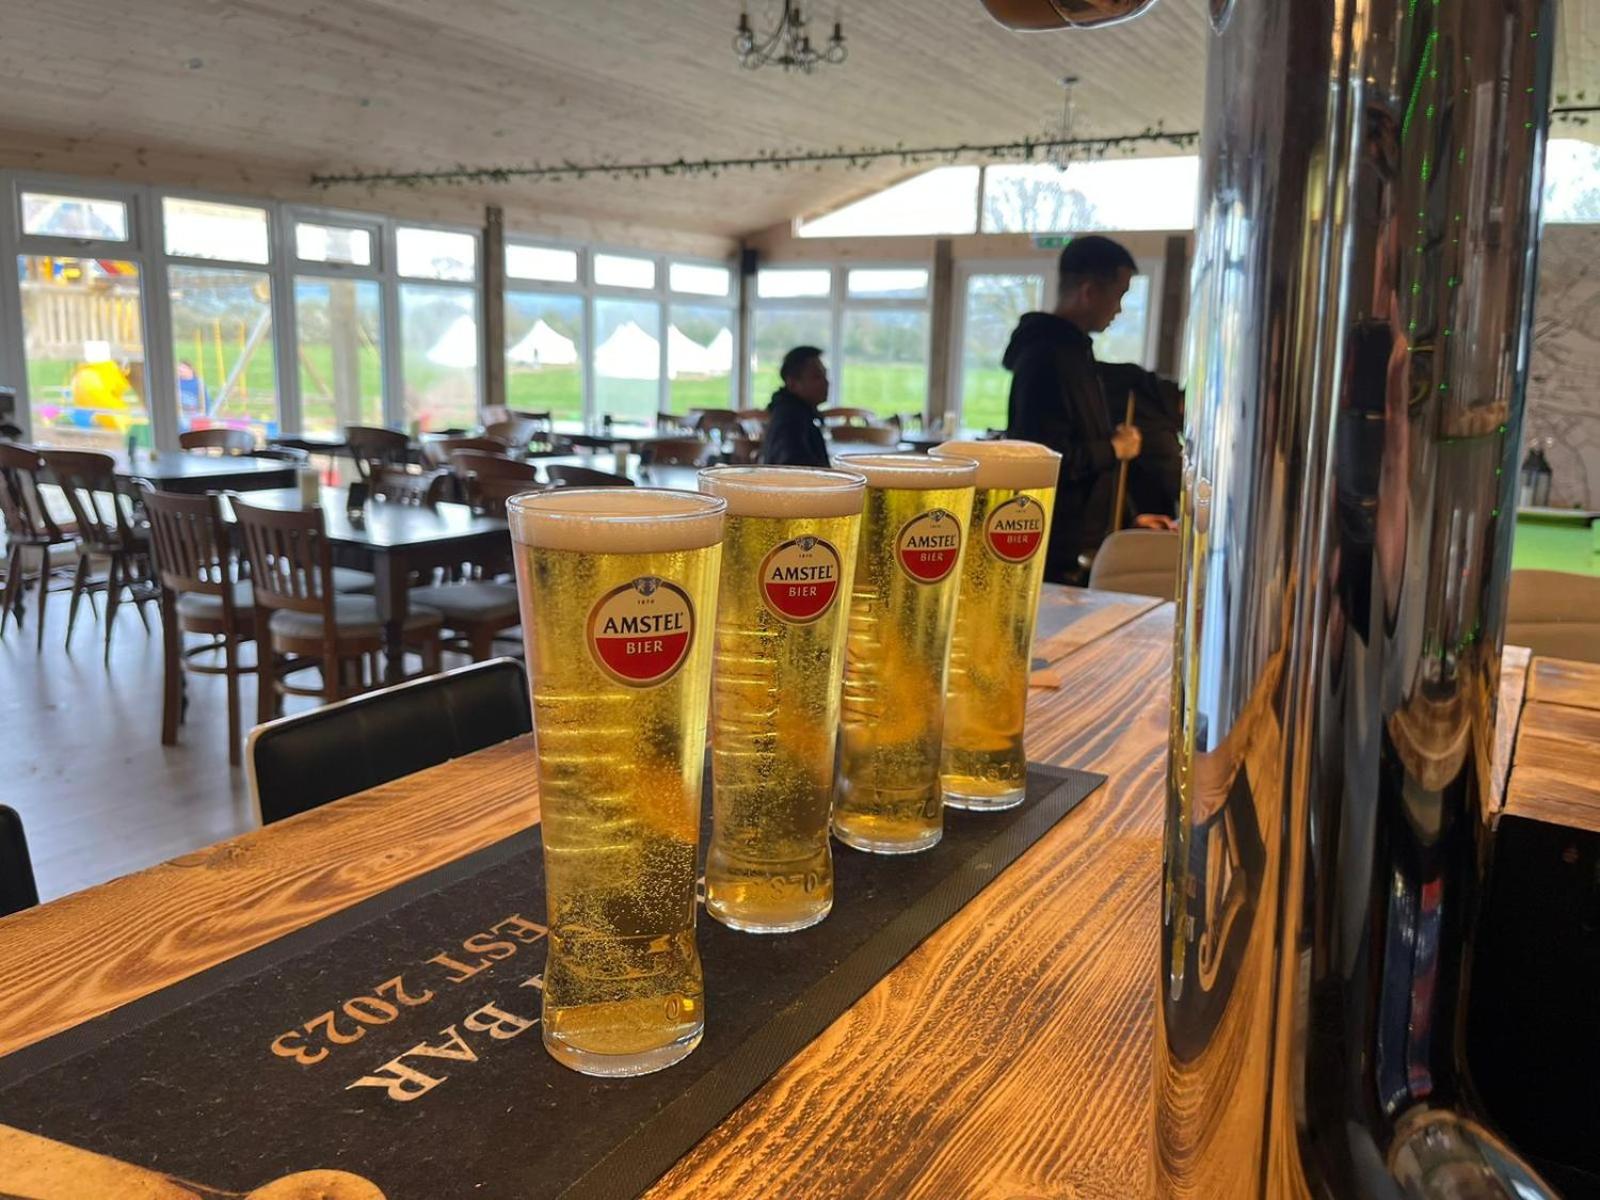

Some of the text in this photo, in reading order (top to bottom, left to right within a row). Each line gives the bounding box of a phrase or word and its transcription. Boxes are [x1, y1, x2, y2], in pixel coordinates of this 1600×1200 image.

[994, 519, 1040, 531] AMSTEL
[907, 535, 956, 548] AMSTEL
[920, 552, 944, 562] BIER
[772, 565, 833, 581] AMSTEL
[788, 586, 817, 597] BIER
[603, 612, 684, 634] AMSTEL
[626, 640, 663, 654] BIER
[270, 913, 548, 1066] EST 2023
[344, 1001, 540, 1102] BAR
